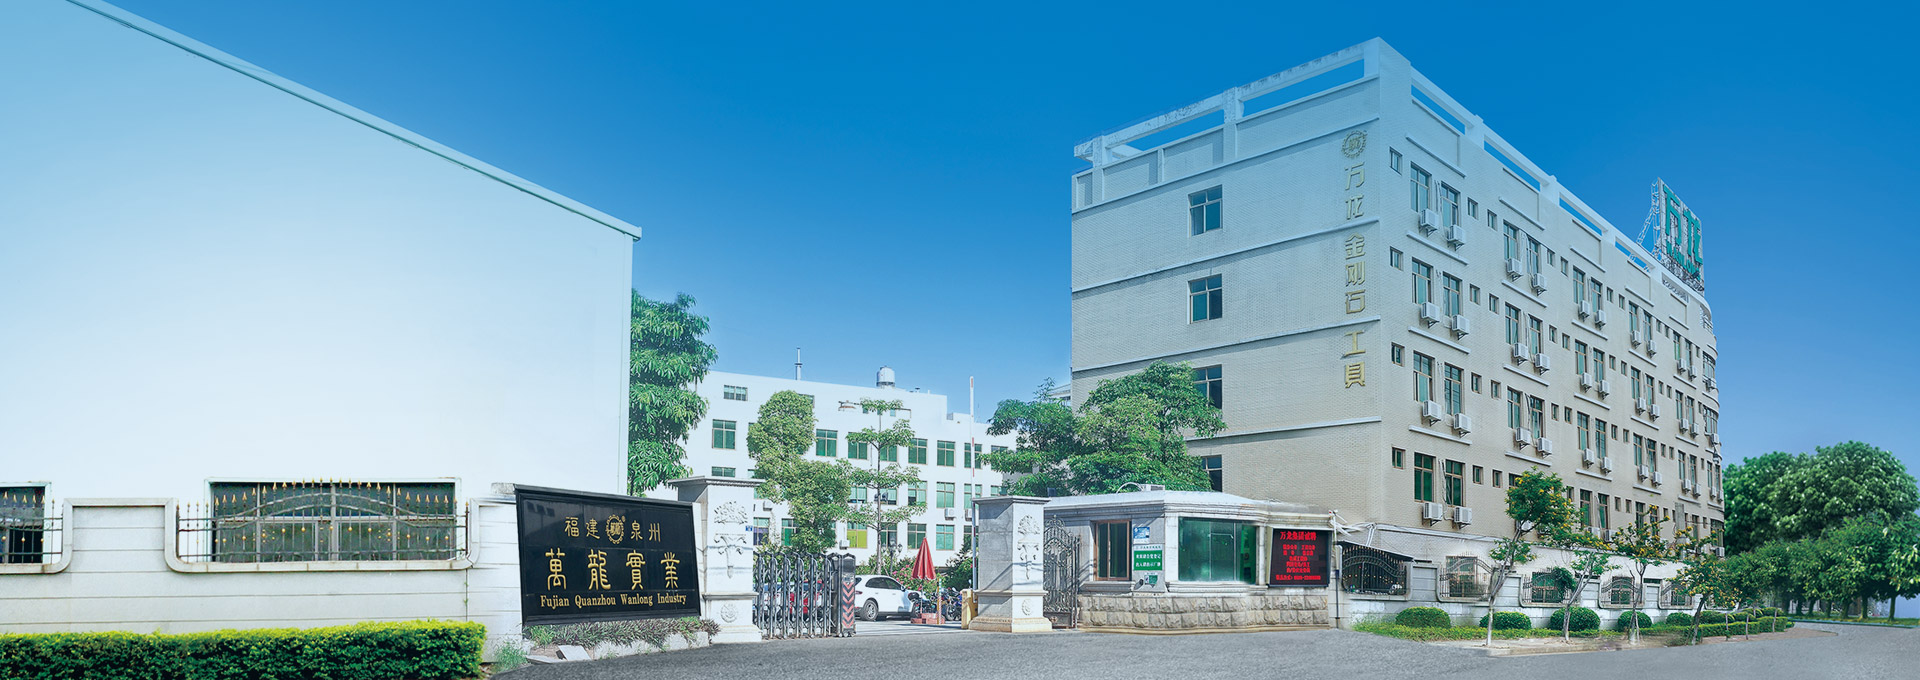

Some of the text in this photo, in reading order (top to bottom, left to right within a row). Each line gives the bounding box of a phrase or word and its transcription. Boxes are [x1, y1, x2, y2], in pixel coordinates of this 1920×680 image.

[545, 547, 680, 591] 萬龍實業
[540, 592, 687, 610] Fujian Quanzhou Wanlong Industry
